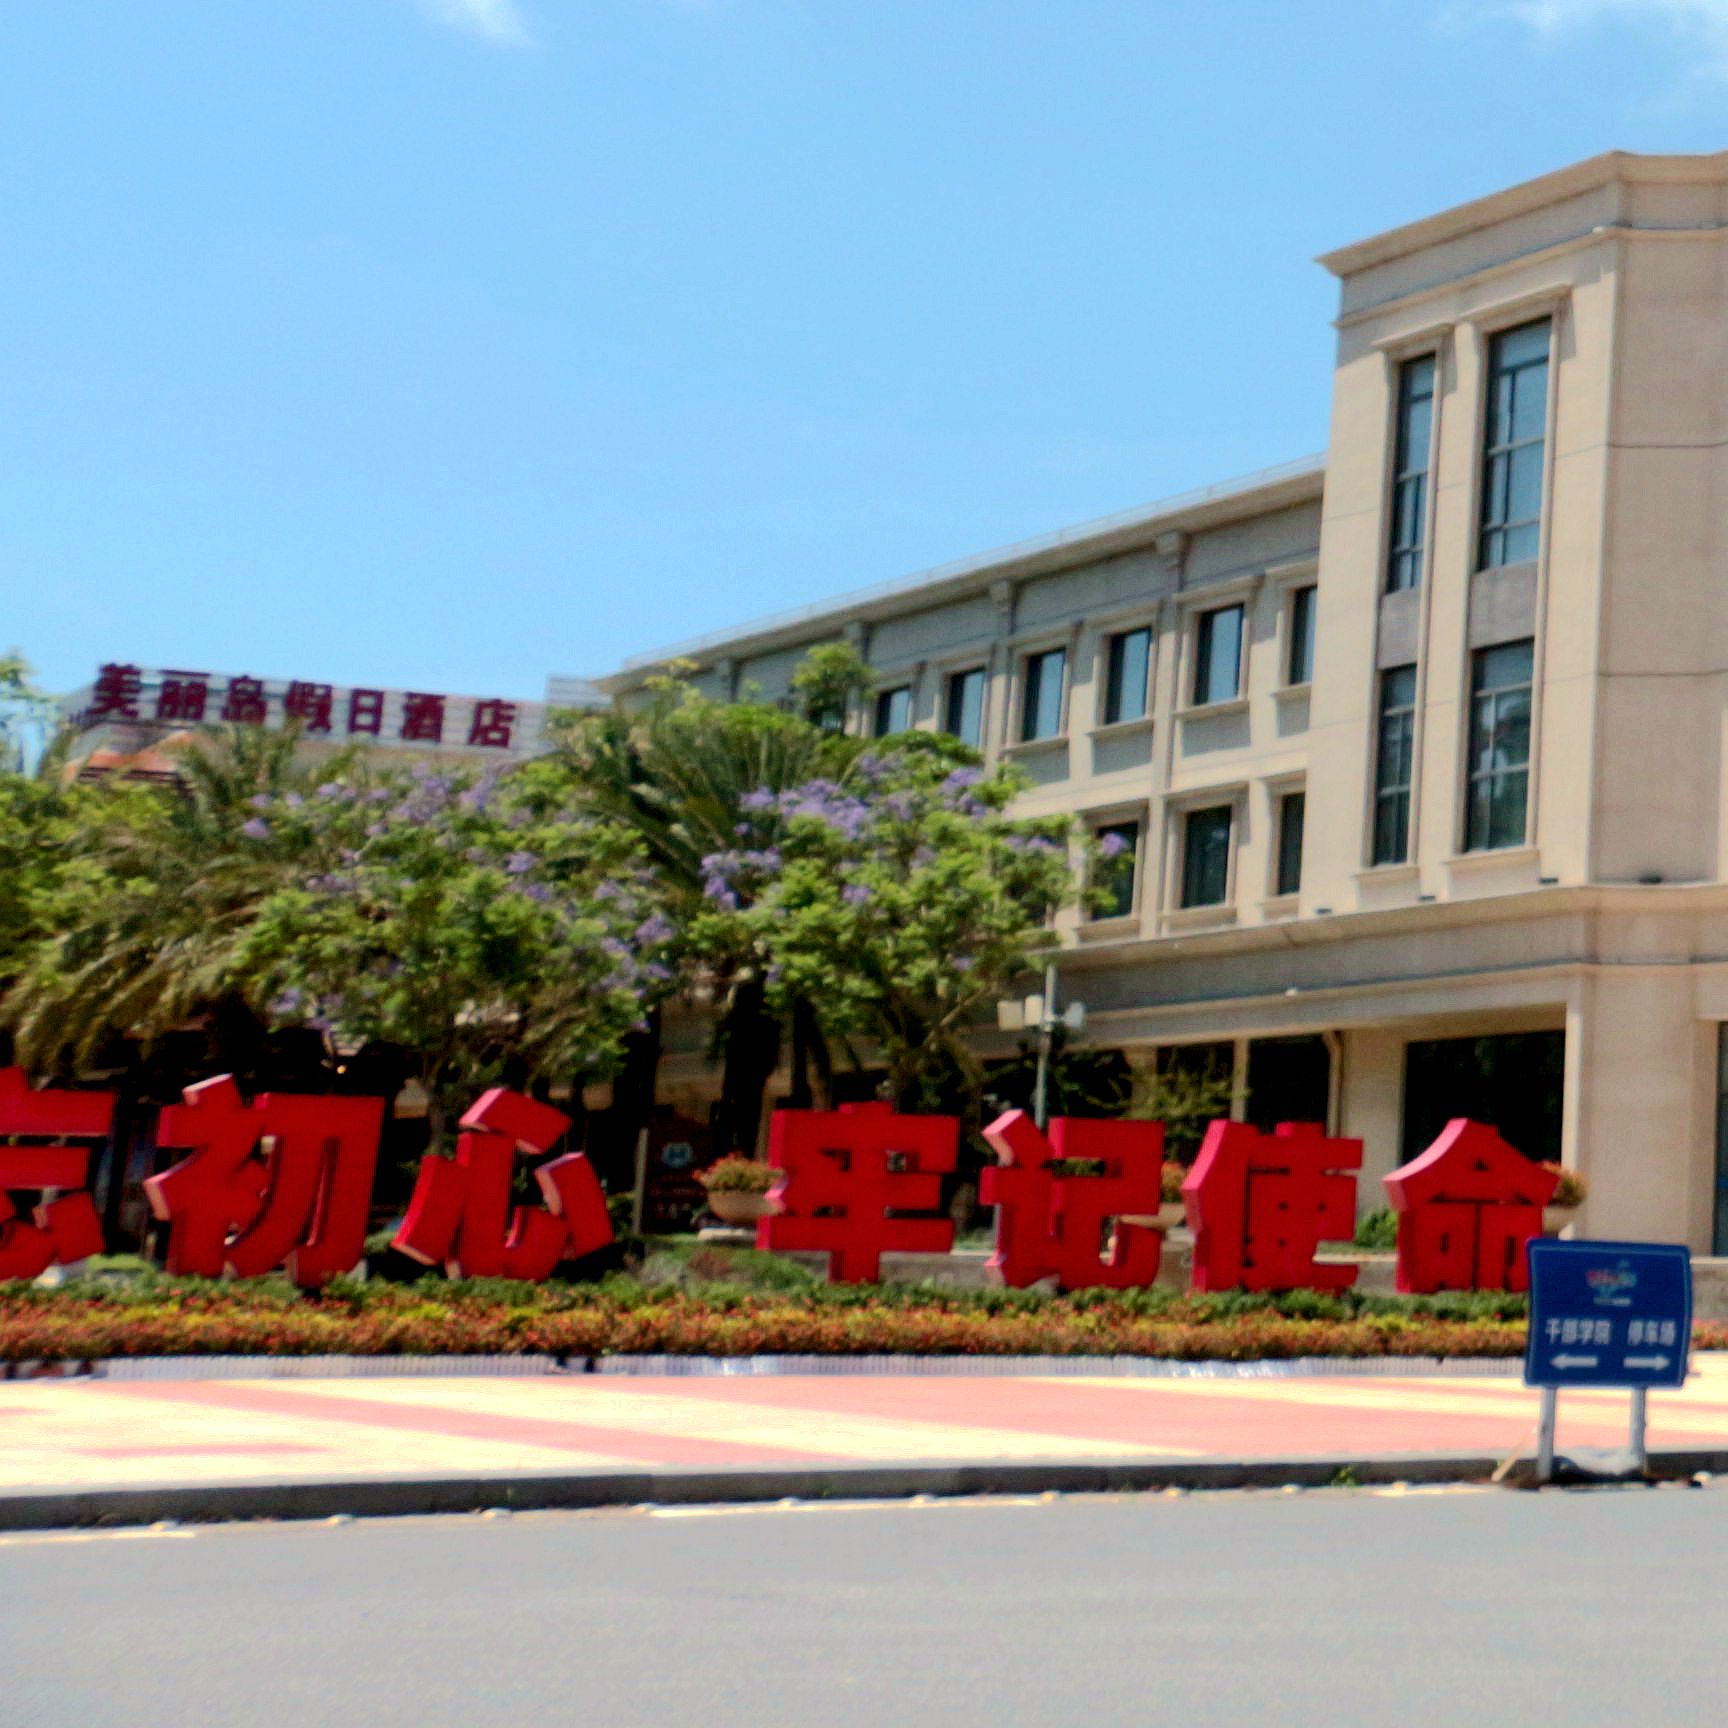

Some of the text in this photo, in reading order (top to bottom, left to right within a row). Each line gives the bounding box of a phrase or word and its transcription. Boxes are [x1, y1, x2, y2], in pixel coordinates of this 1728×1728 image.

[90, 663, 517, 747] 美丽岛假日酒店
[756, 1101, 1559, 1293] 牢记使命
